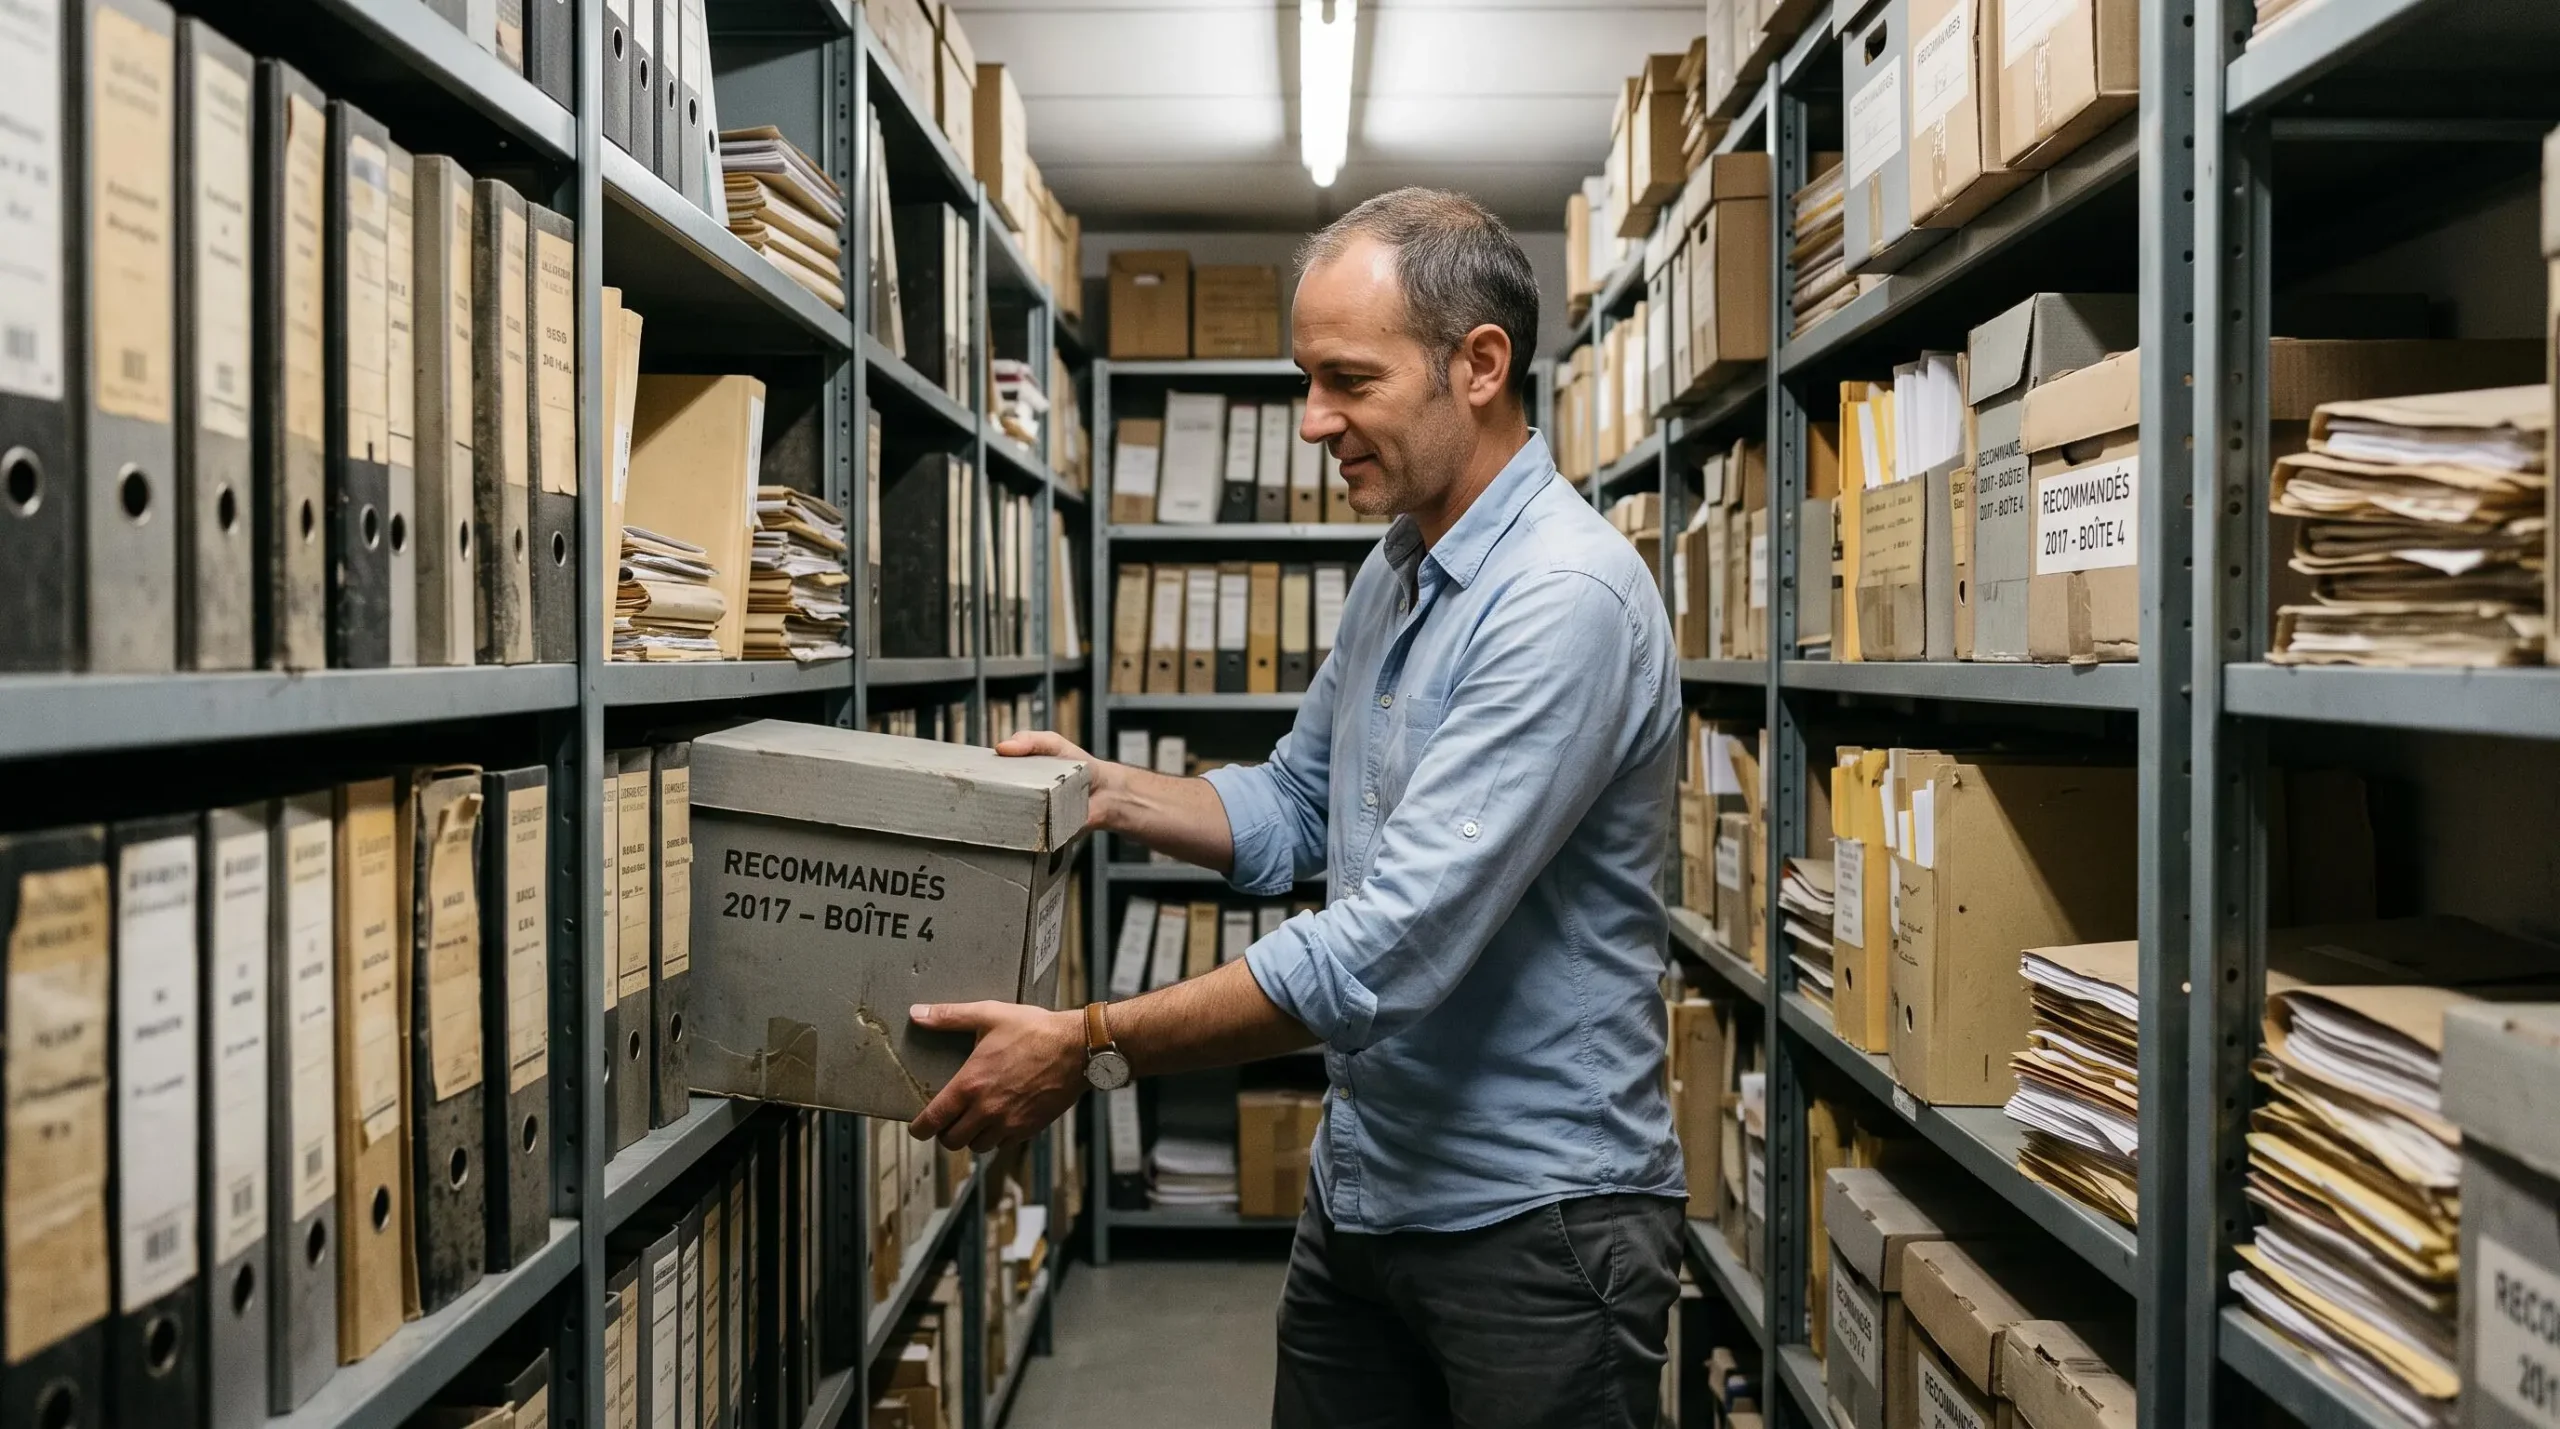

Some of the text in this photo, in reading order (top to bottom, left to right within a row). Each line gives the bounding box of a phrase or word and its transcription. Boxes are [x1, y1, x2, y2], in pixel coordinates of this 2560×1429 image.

[2043, 466, 2130, 515] RECOMMANDÉS
[2045, 529, 2068, 555] 2017
[2079, 516, 2113, 551] BOÎTE
[2117, 519, 2125, 545] 4
[724, 849, 946, 901] RECOMMANDÉS
[722, 892, 791, 924] 2017
[824, 902, 910, 940] BOÎTE
[917, 916, 934, 942] 4
[2495, 1271, 2560, 1345] RECO
